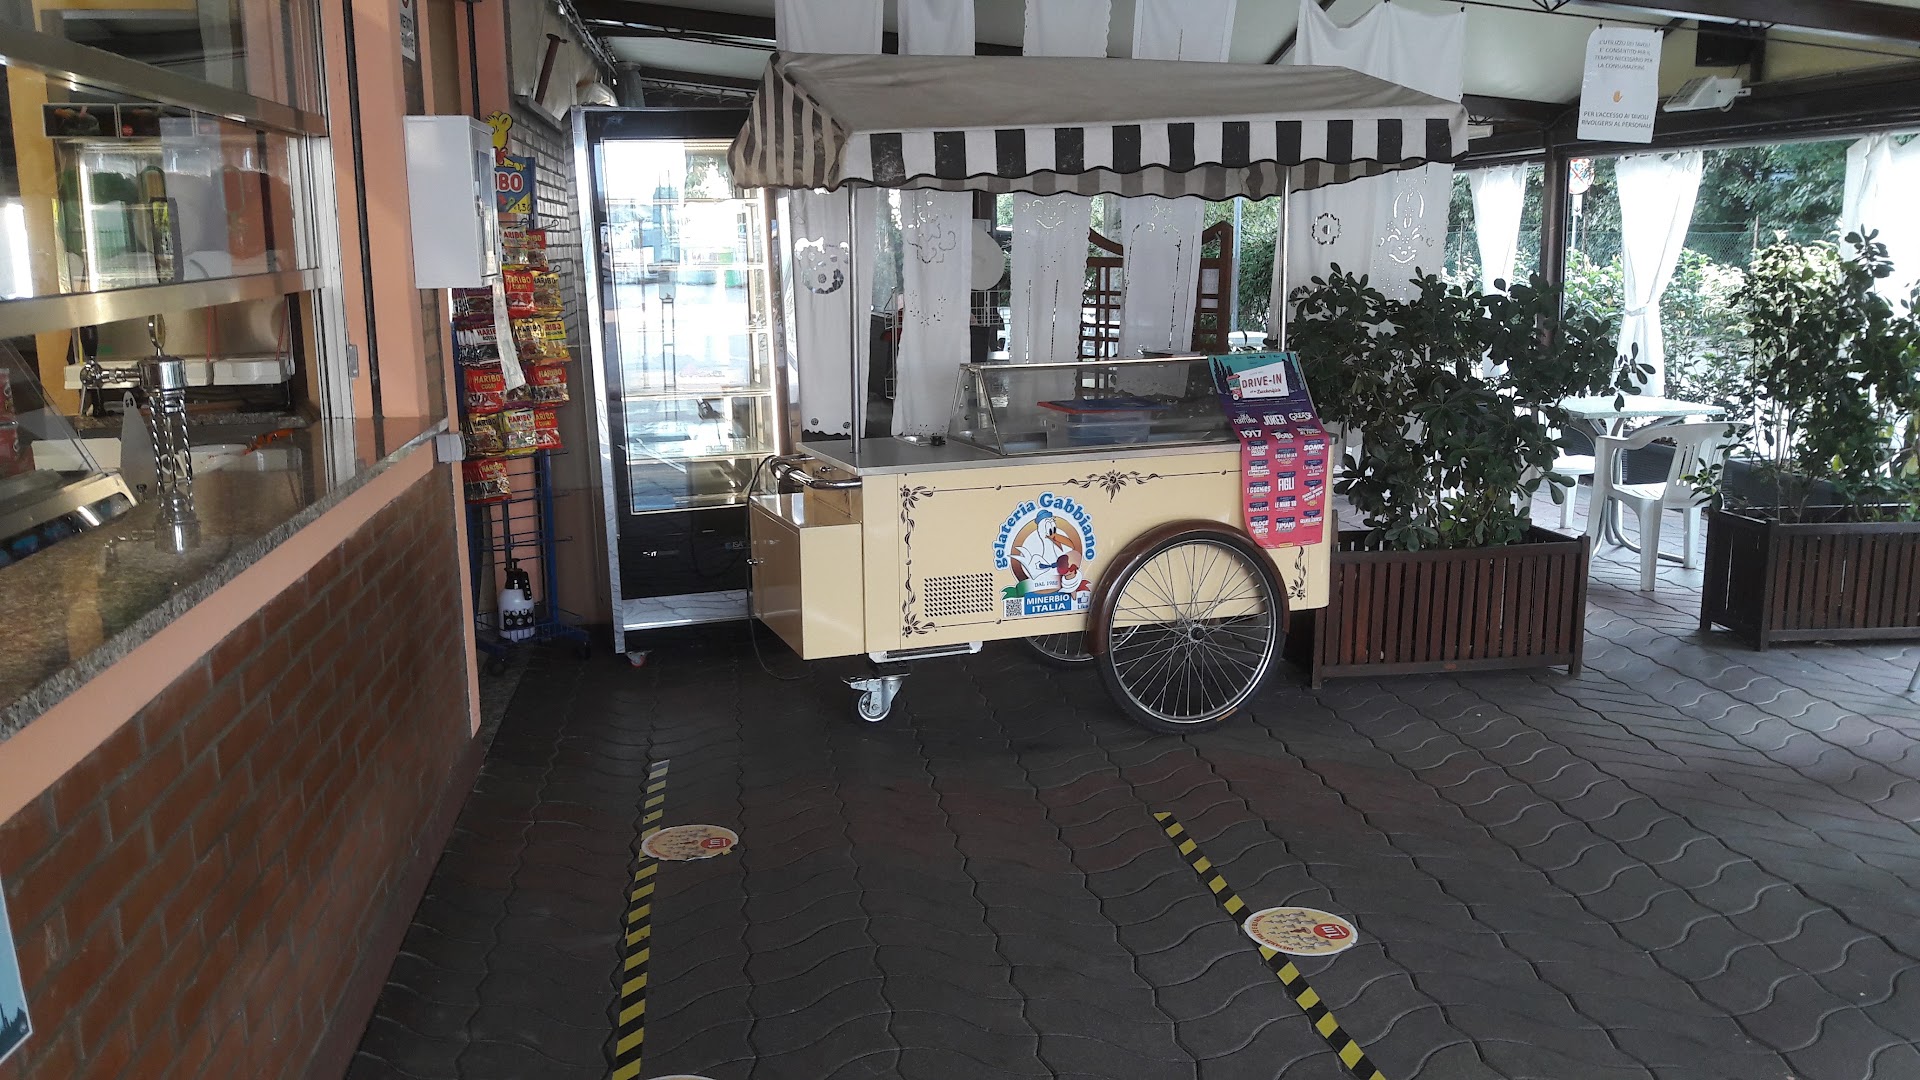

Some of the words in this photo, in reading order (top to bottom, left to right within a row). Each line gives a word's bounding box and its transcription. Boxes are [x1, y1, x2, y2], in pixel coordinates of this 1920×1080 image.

[538, 368, 562, 377] HARIBO
[474, 375, 500, 383] HARIBO
[1242, 373, 1282, 388] DRIVE-IN
[473, 419, 496, 427] HARIBO
[507, 414, 531, 423] HARIBO
[1263, 415, 1287, 425] JOKER
[1240, 430, 1262, 438] 1917
[1278, 477, 1295, 491] FIGLI
[995, 502, 1036, 569] gelateria
[1040, 493, 1095, 560] Gabbiano
[1026, 594, 1070, 605] MINERBIO
[1032, 603, 1066, 613] ITALIA
[1322, 926, 1340, 938] 1m
